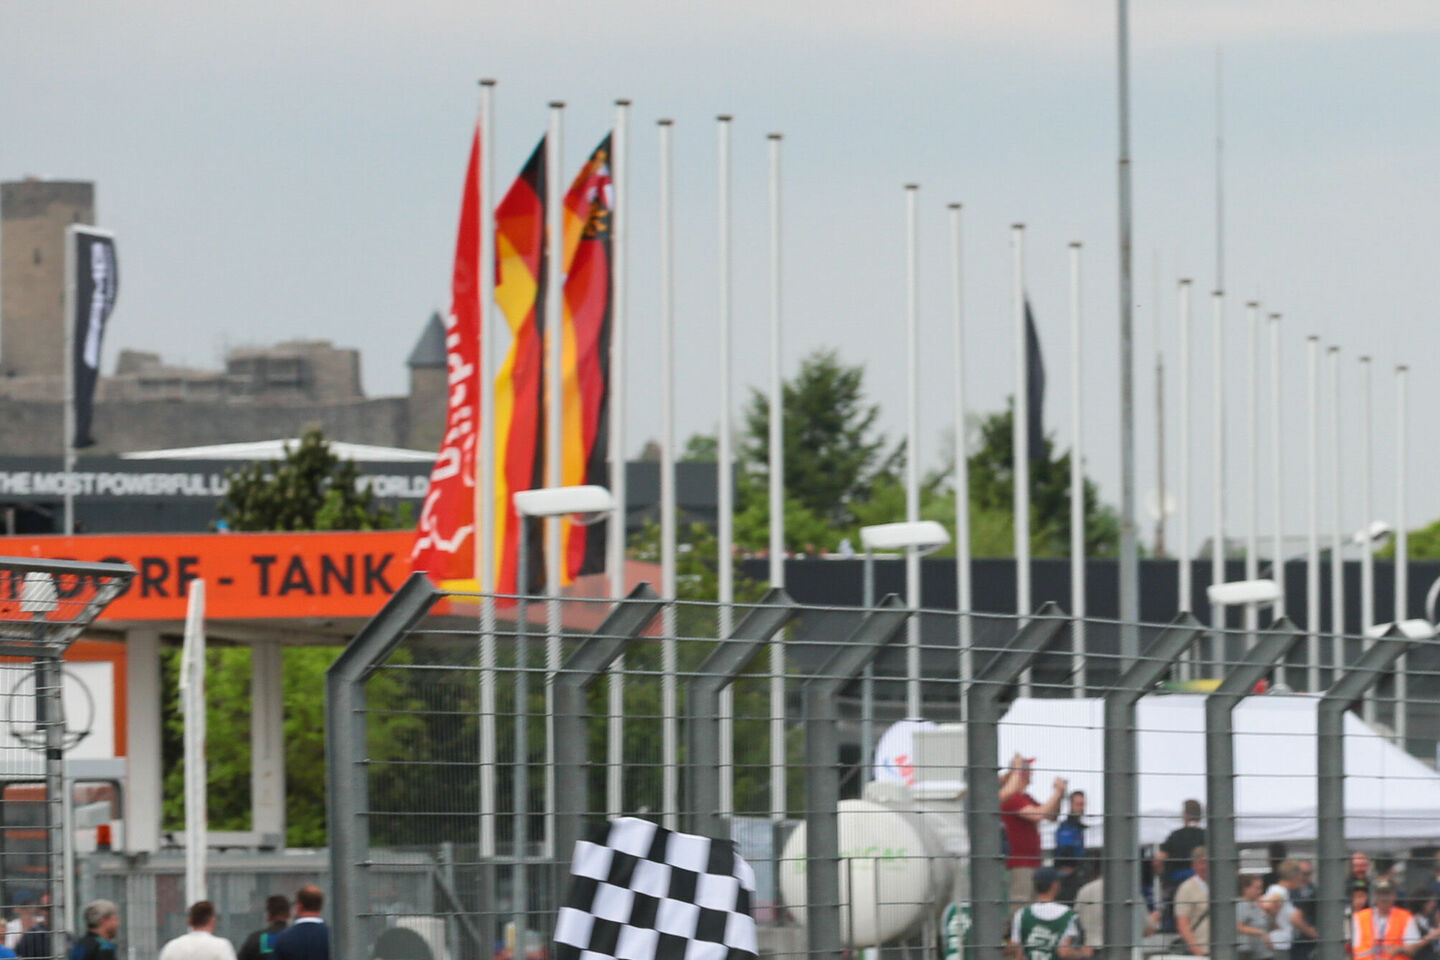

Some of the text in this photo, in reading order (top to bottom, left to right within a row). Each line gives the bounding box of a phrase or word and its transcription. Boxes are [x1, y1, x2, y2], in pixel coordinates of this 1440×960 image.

[33, 472, 96, 495] MOST
[98, 473, 208, 496] POWERFUL
[251, 553, 400, 597] TANK
